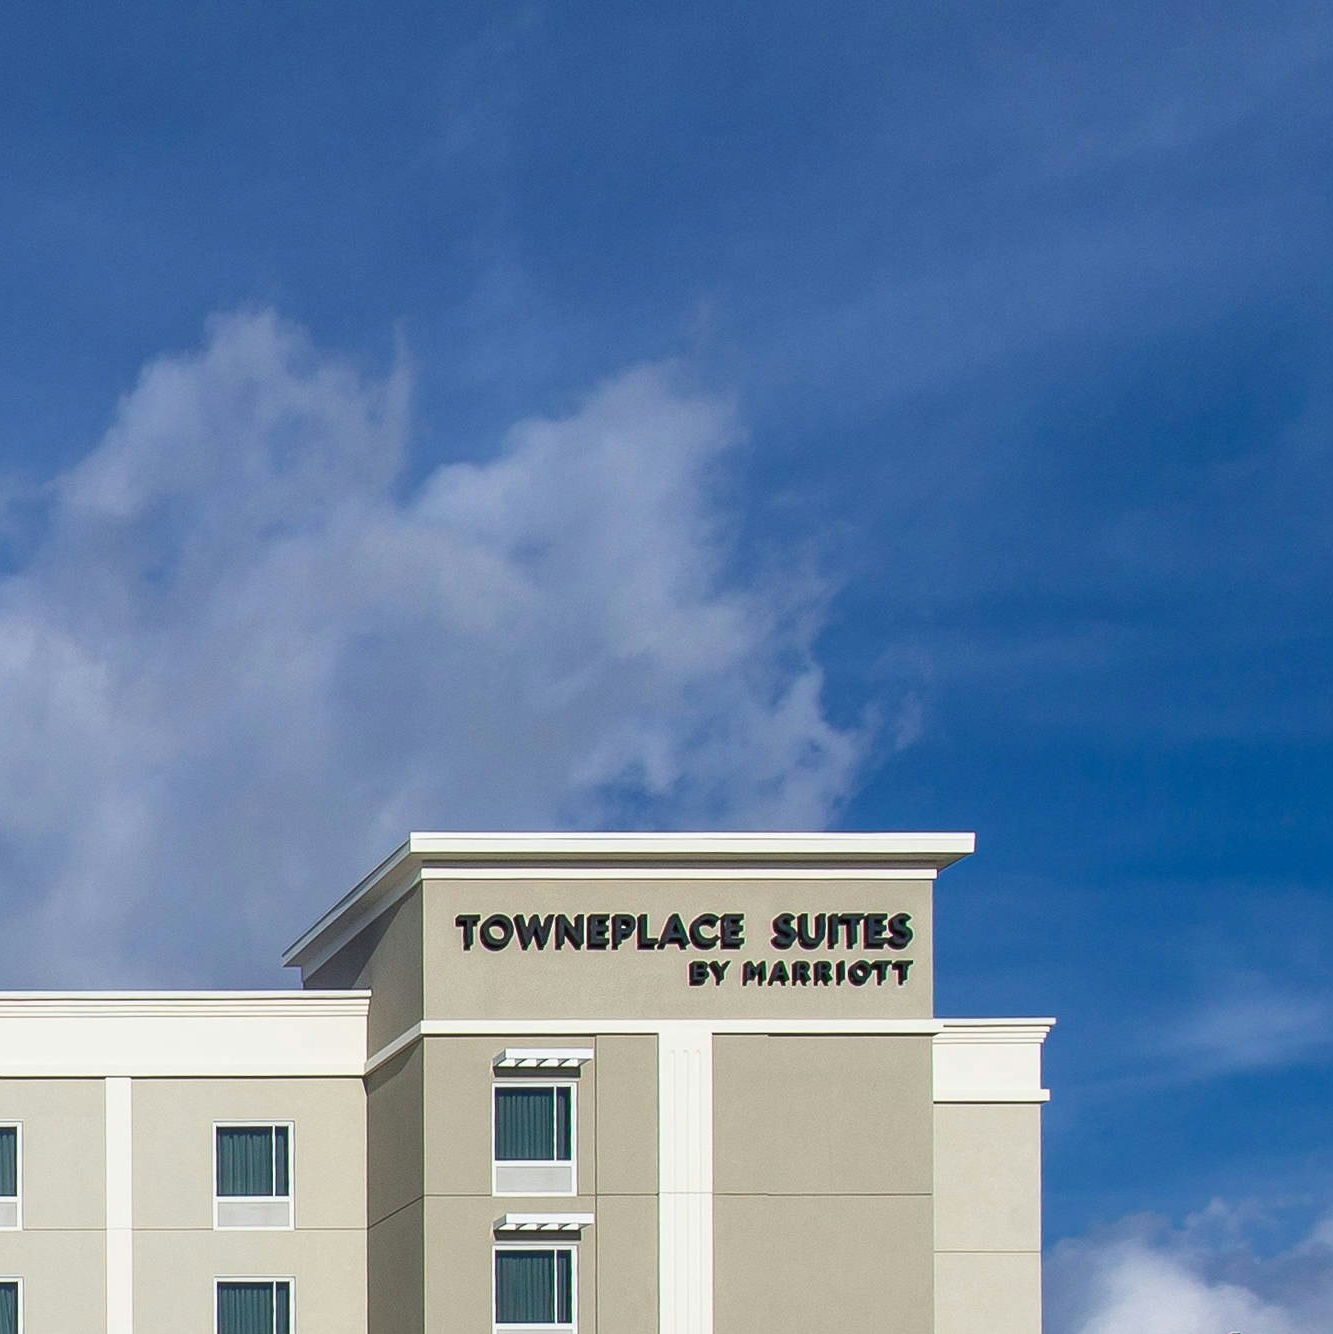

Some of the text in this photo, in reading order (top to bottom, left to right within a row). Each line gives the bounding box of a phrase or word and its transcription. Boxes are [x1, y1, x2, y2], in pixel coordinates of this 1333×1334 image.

[455, 913, 914, 951] TOWNEPLACE SUITES
[689, 959, 913, 987] BY MARRIOTT
